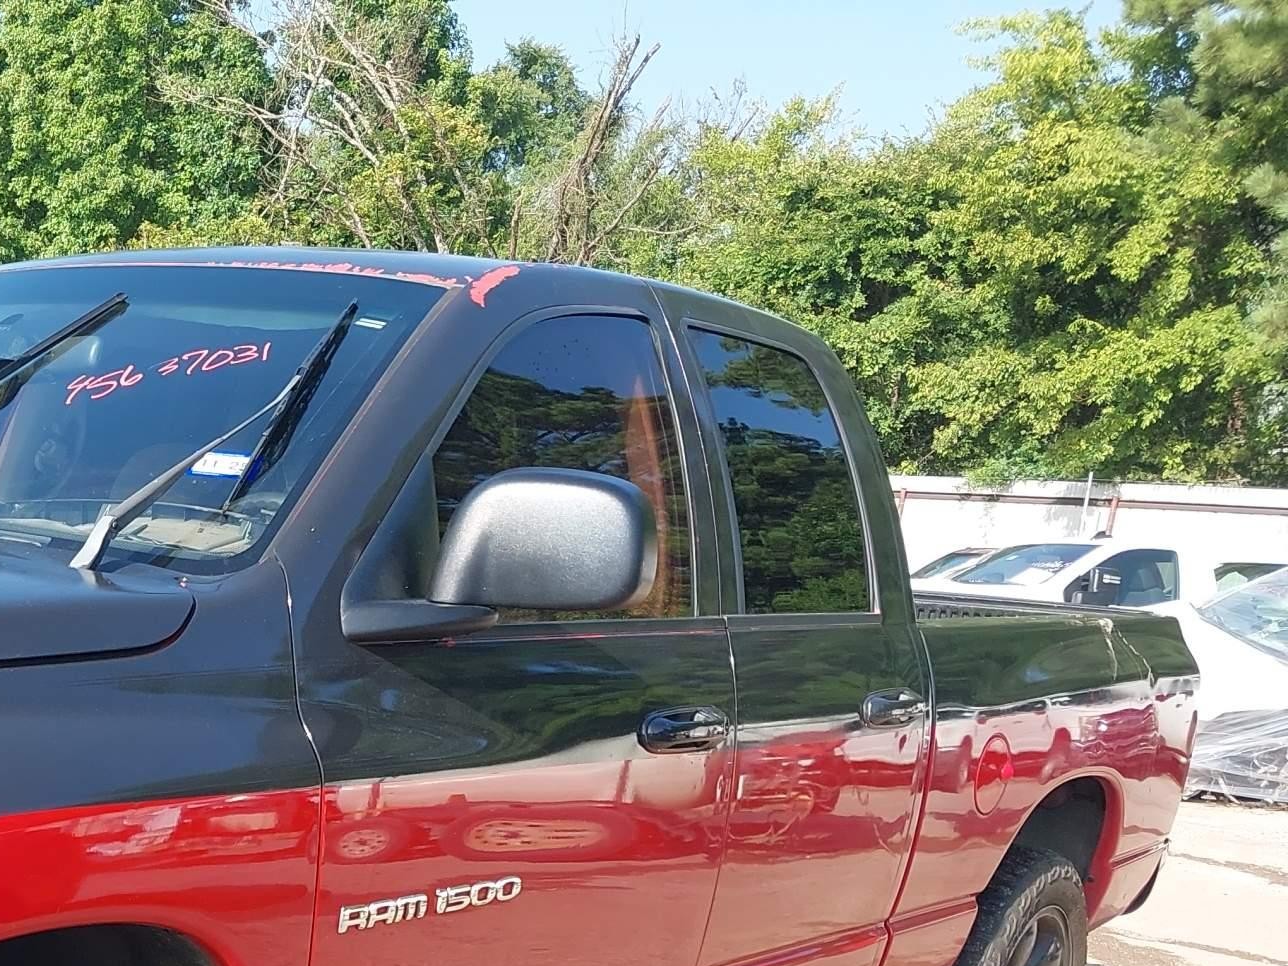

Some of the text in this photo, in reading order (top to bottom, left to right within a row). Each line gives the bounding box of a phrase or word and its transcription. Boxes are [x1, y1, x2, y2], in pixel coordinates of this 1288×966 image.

[65, 341, 272, 406] 456 37031
[337, 875, 522, 934] RAM 1500
